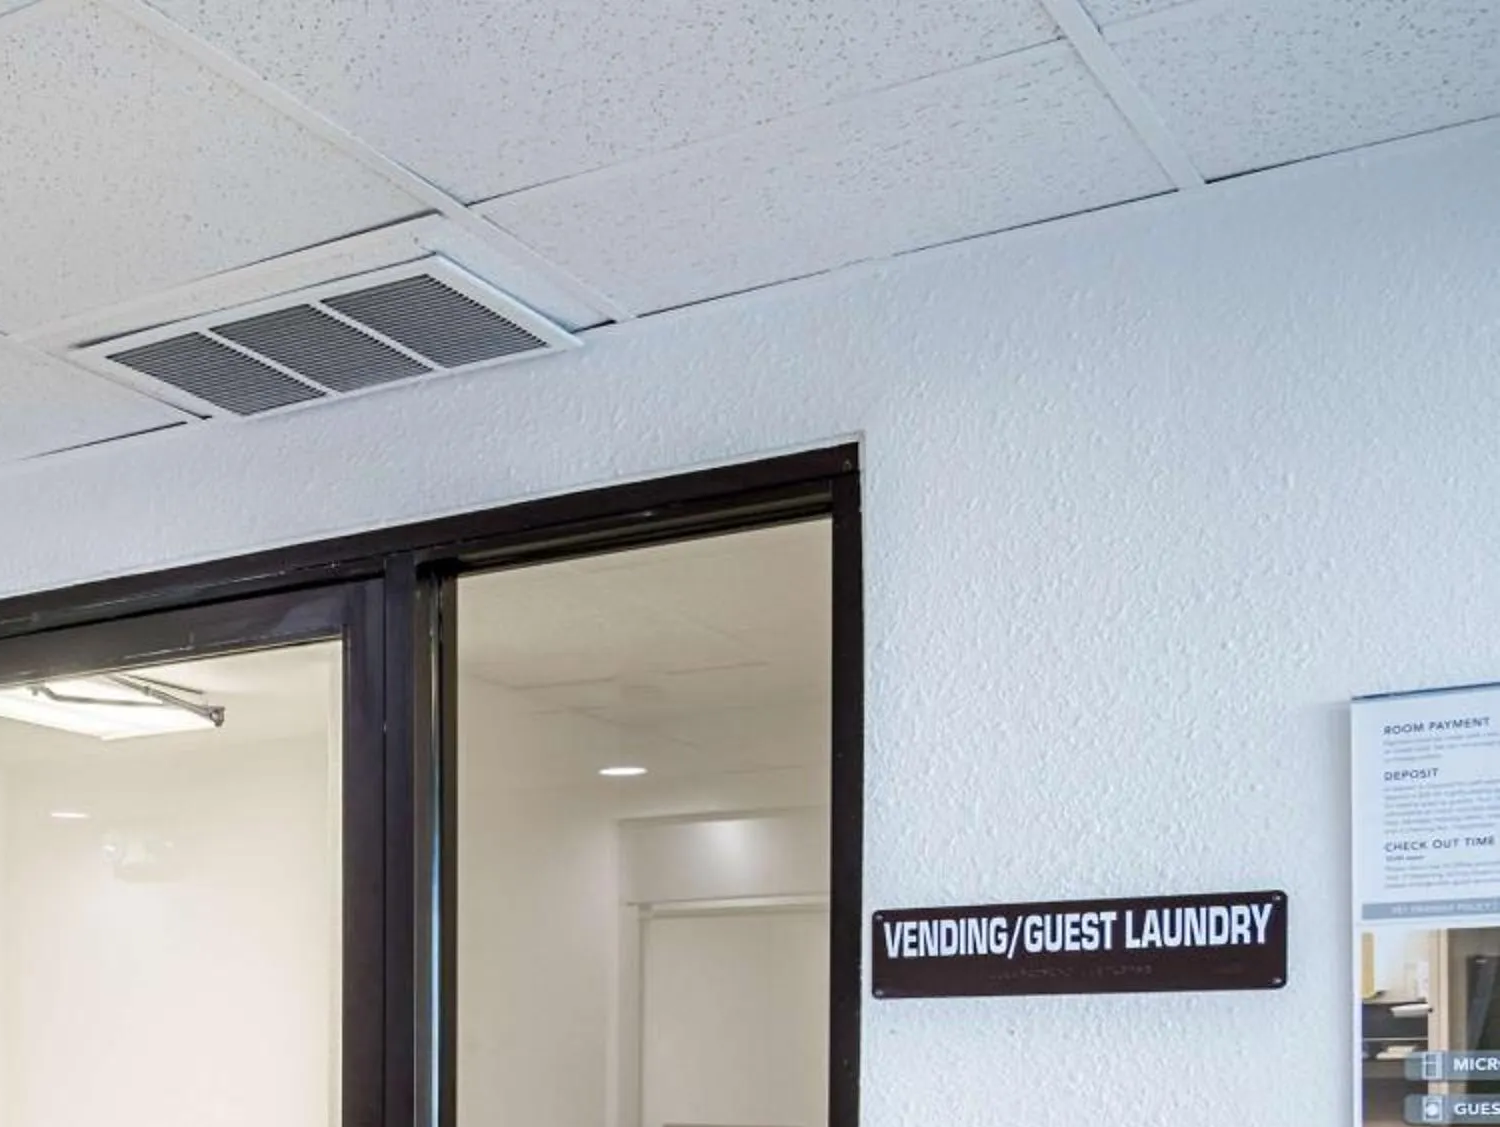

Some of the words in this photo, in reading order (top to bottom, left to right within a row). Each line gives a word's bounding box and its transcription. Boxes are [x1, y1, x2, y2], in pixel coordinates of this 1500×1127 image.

[1384, 722, 1424, 734] ROOM
[1428, 717, 1490, 731] PAYMENT
[1384, 767, 1438, 781] DEPOSIT
[1384, 841, 1428, 852] CHECK
[1432, 838, 1459, 849] OUT
[1464, 836, 1495, 846] TIME
[883, 909, 1117, 960] VENDING/GUEST
[1124, 903, 1273, 950] LAUNDRY
[1453, 1057, 1500, 1071] MICR
